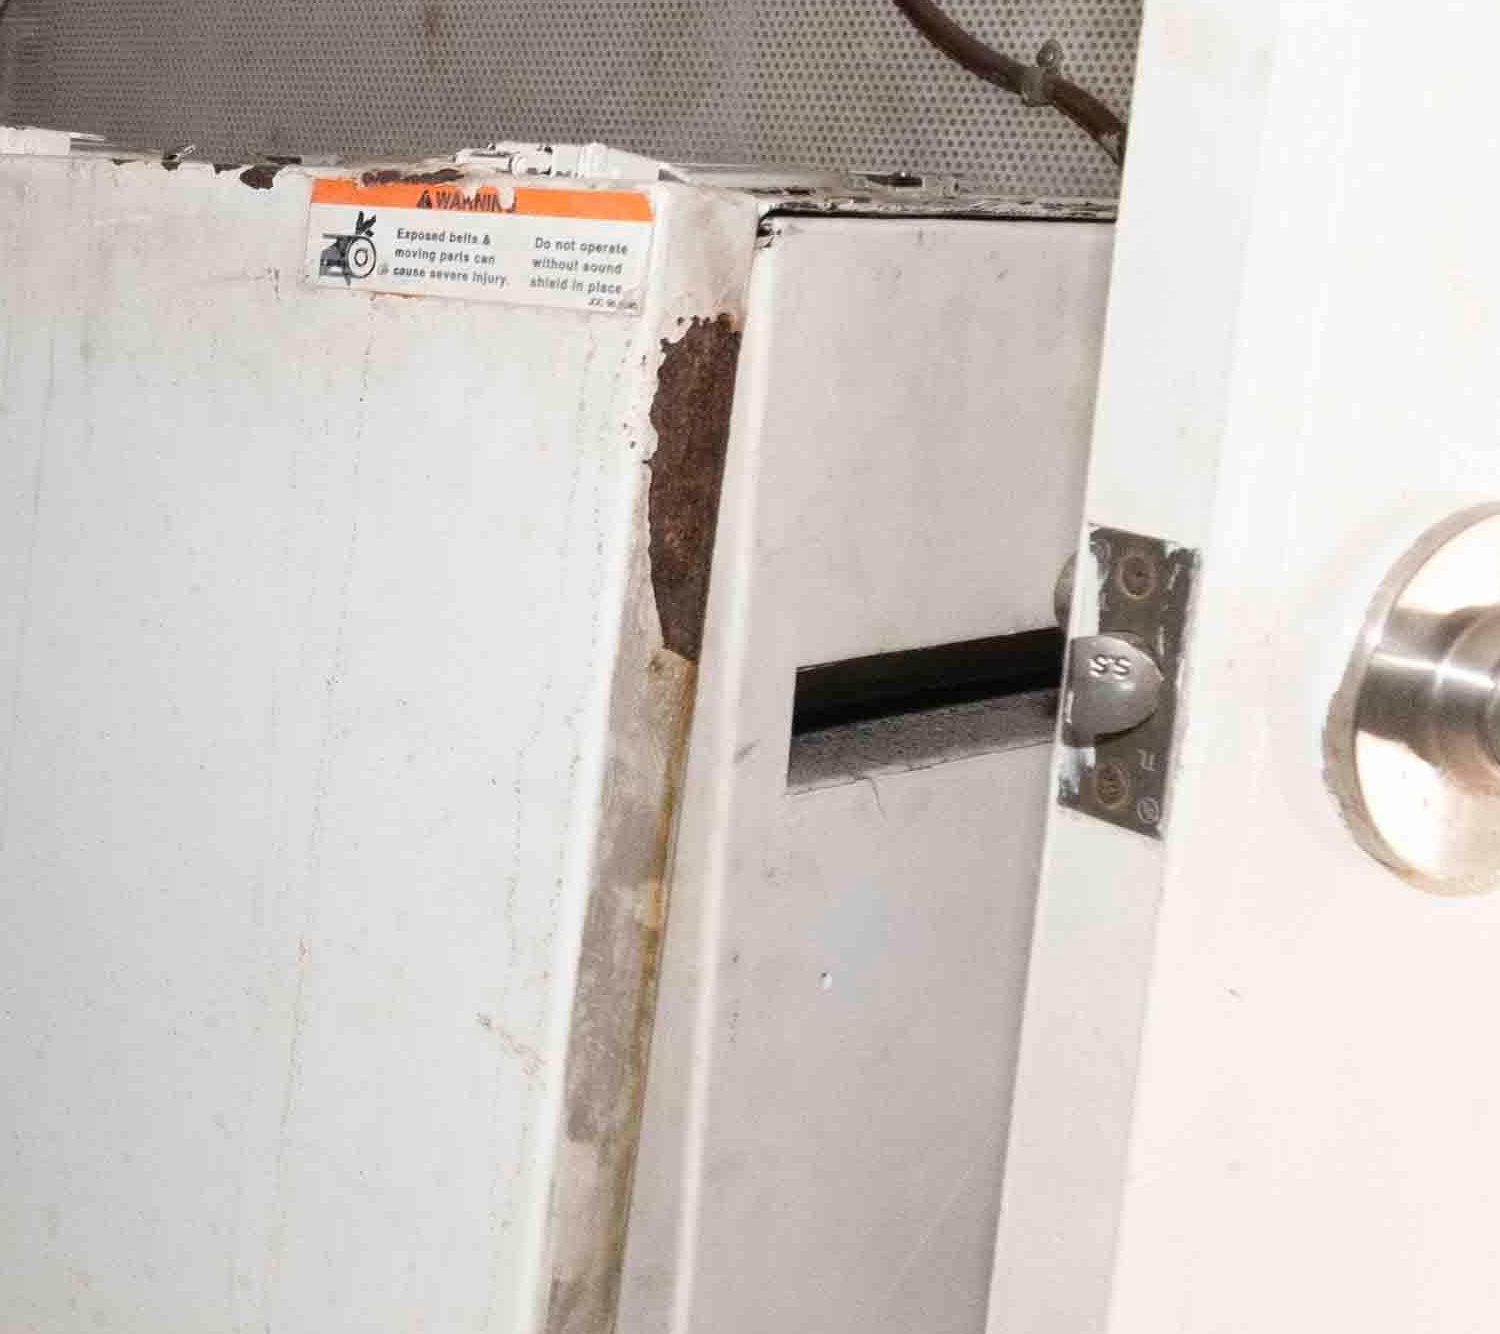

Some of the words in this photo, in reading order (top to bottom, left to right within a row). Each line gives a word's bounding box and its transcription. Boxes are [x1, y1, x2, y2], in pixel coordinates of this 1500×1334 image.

[397, 228, 445, 244] Exposed
[449, 230, 477, 245] belts
[481, 234, 490, 246] &
[394, 247, 436, 263] moving
[440, 250, 469, 265] parts
[474, 254, 495, 265] can
[535, 237, 551, 249] Do
[555, 239, 576, 251] not
[580, 243, 627, 257] operate
[393, 266, 426, 279] cause
[430, 269, 469, 282] severe
[532, 257, 579, 272] without
[584, 260, 622, 275] sound
[530, 276, 568, 291] shield
[572, 279, 584, 291] in
